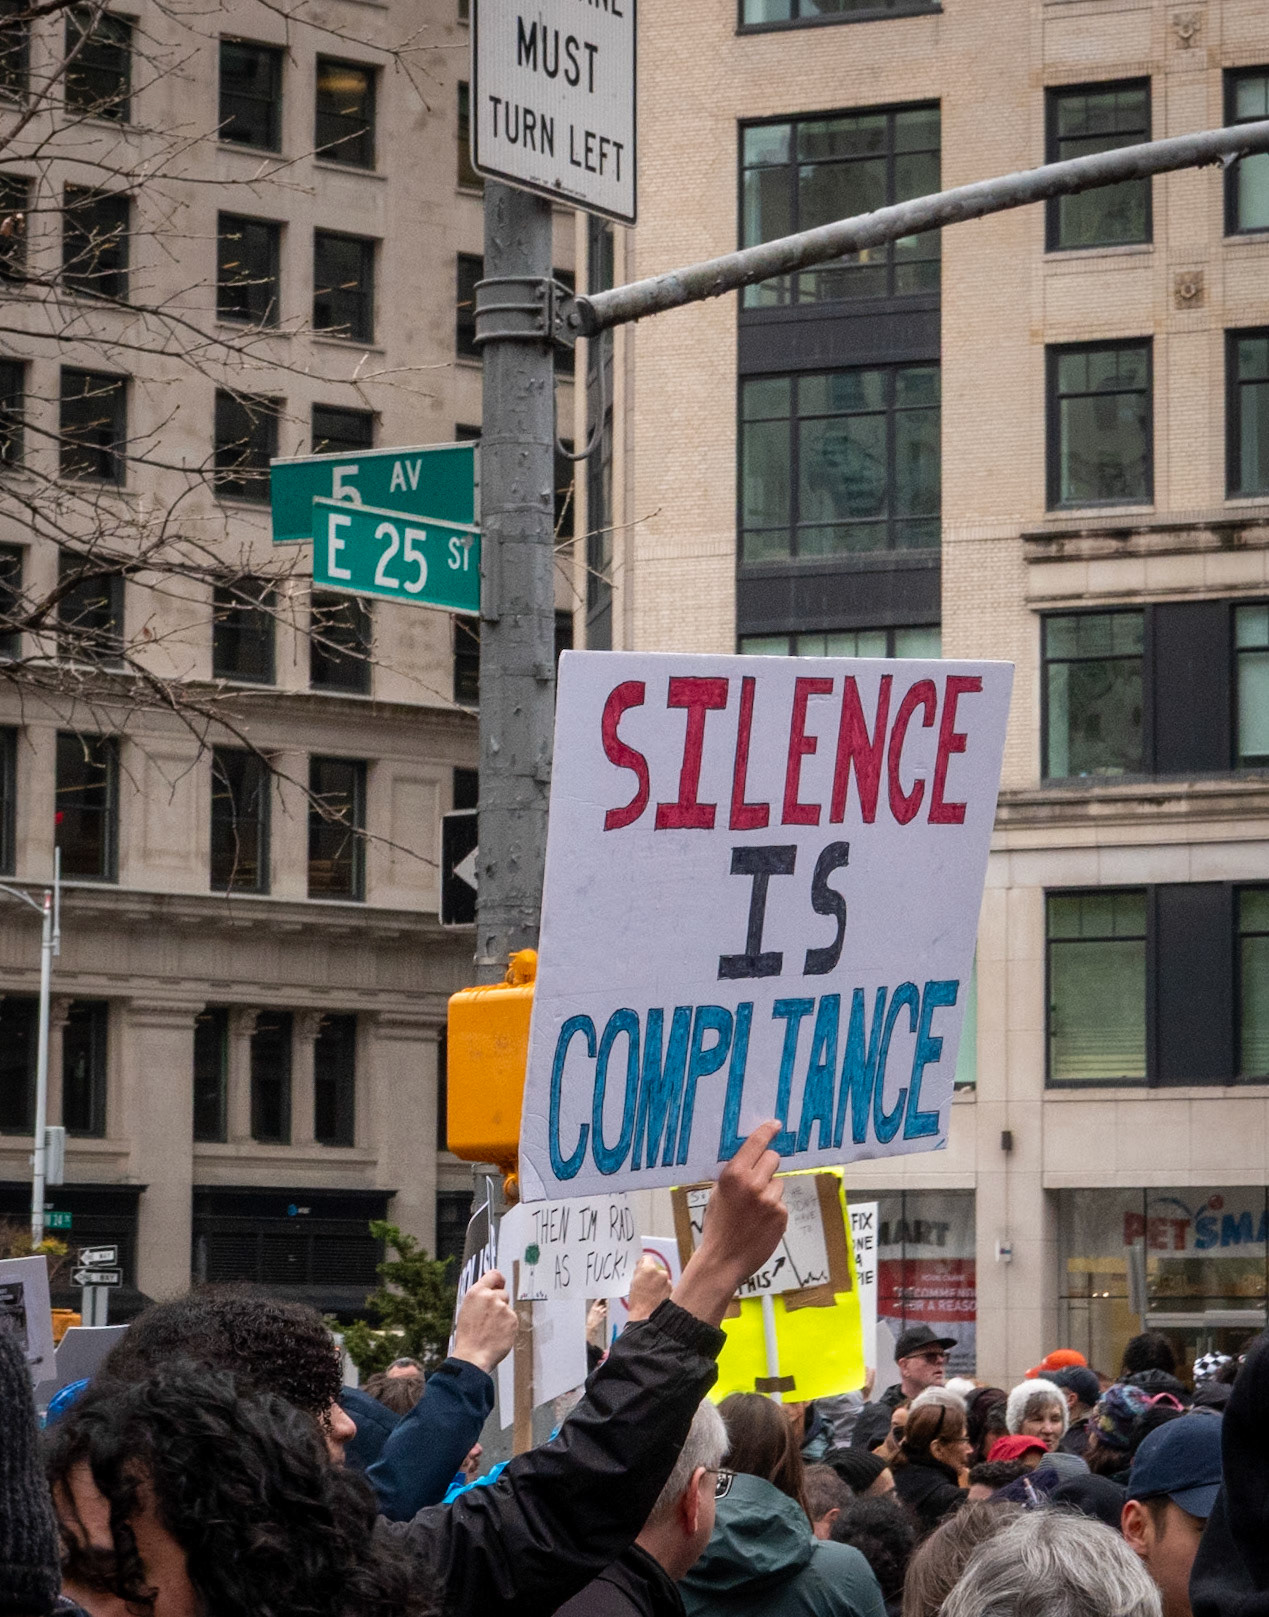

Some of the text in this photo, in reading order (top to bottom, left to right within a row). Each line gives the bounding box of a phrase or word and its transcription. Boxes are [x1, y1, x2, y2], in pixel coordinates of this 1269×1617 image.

[517, 15, 599, 94] MUST
[489, 94, 624, 182] TURN LEFT
[389, 459, 423, 493] AV
[327, 512, 352, 581] E
[374, 521, 429, 594] 25
[601, 674, 984, 832] SILENCE
[717, 840, 850, 981] IS
[548, 978, 960, 1182] COMPLIANCE
[532, 1206, 570, 1244] THEN
[609, 1204, 635, 1242] RAD
[851, 1212, 873, 1231] FIX
[554, 1249, 629, 1290] AS FUCK!
[738, 1270, 772, 1295] THIS
